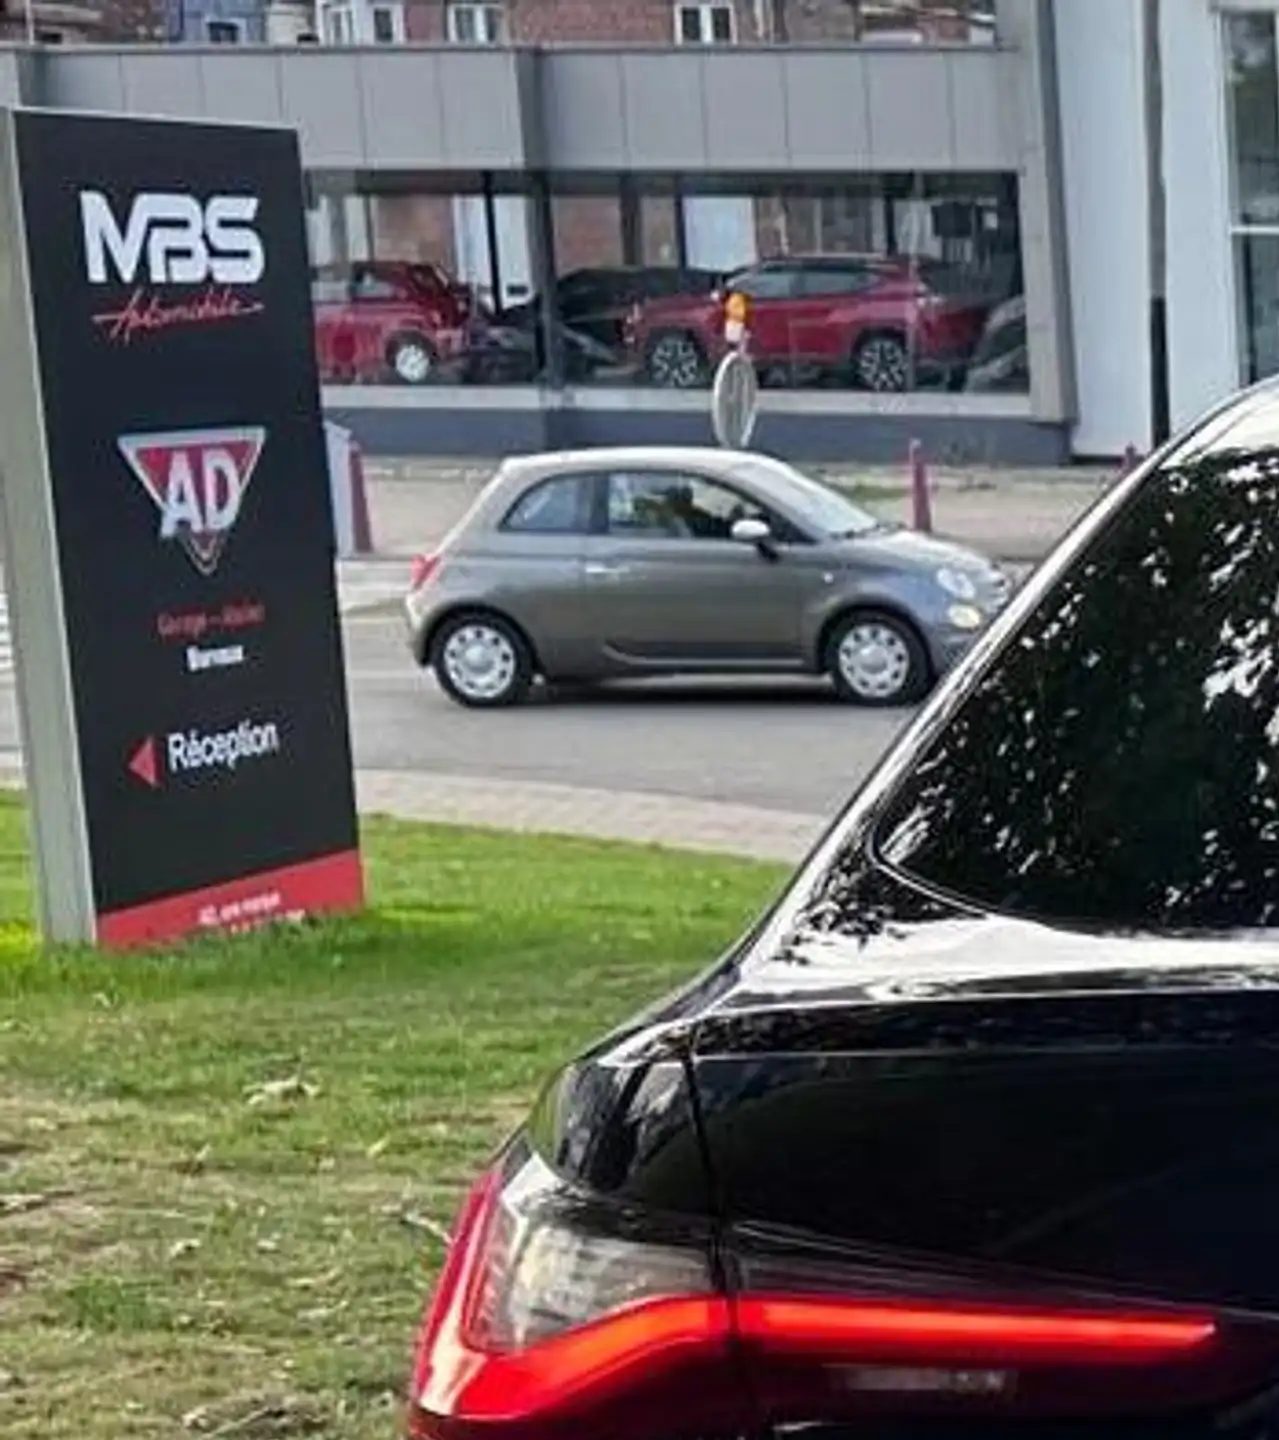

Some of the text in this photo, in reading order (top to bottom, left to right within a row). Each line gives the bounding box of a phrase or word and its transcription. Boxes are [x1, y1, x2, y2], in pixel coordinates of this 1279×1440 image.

[80, 190, 266, 284] MBS
[161, 447, 242, 538] AD
[167, 717, 280, 773] Réception
